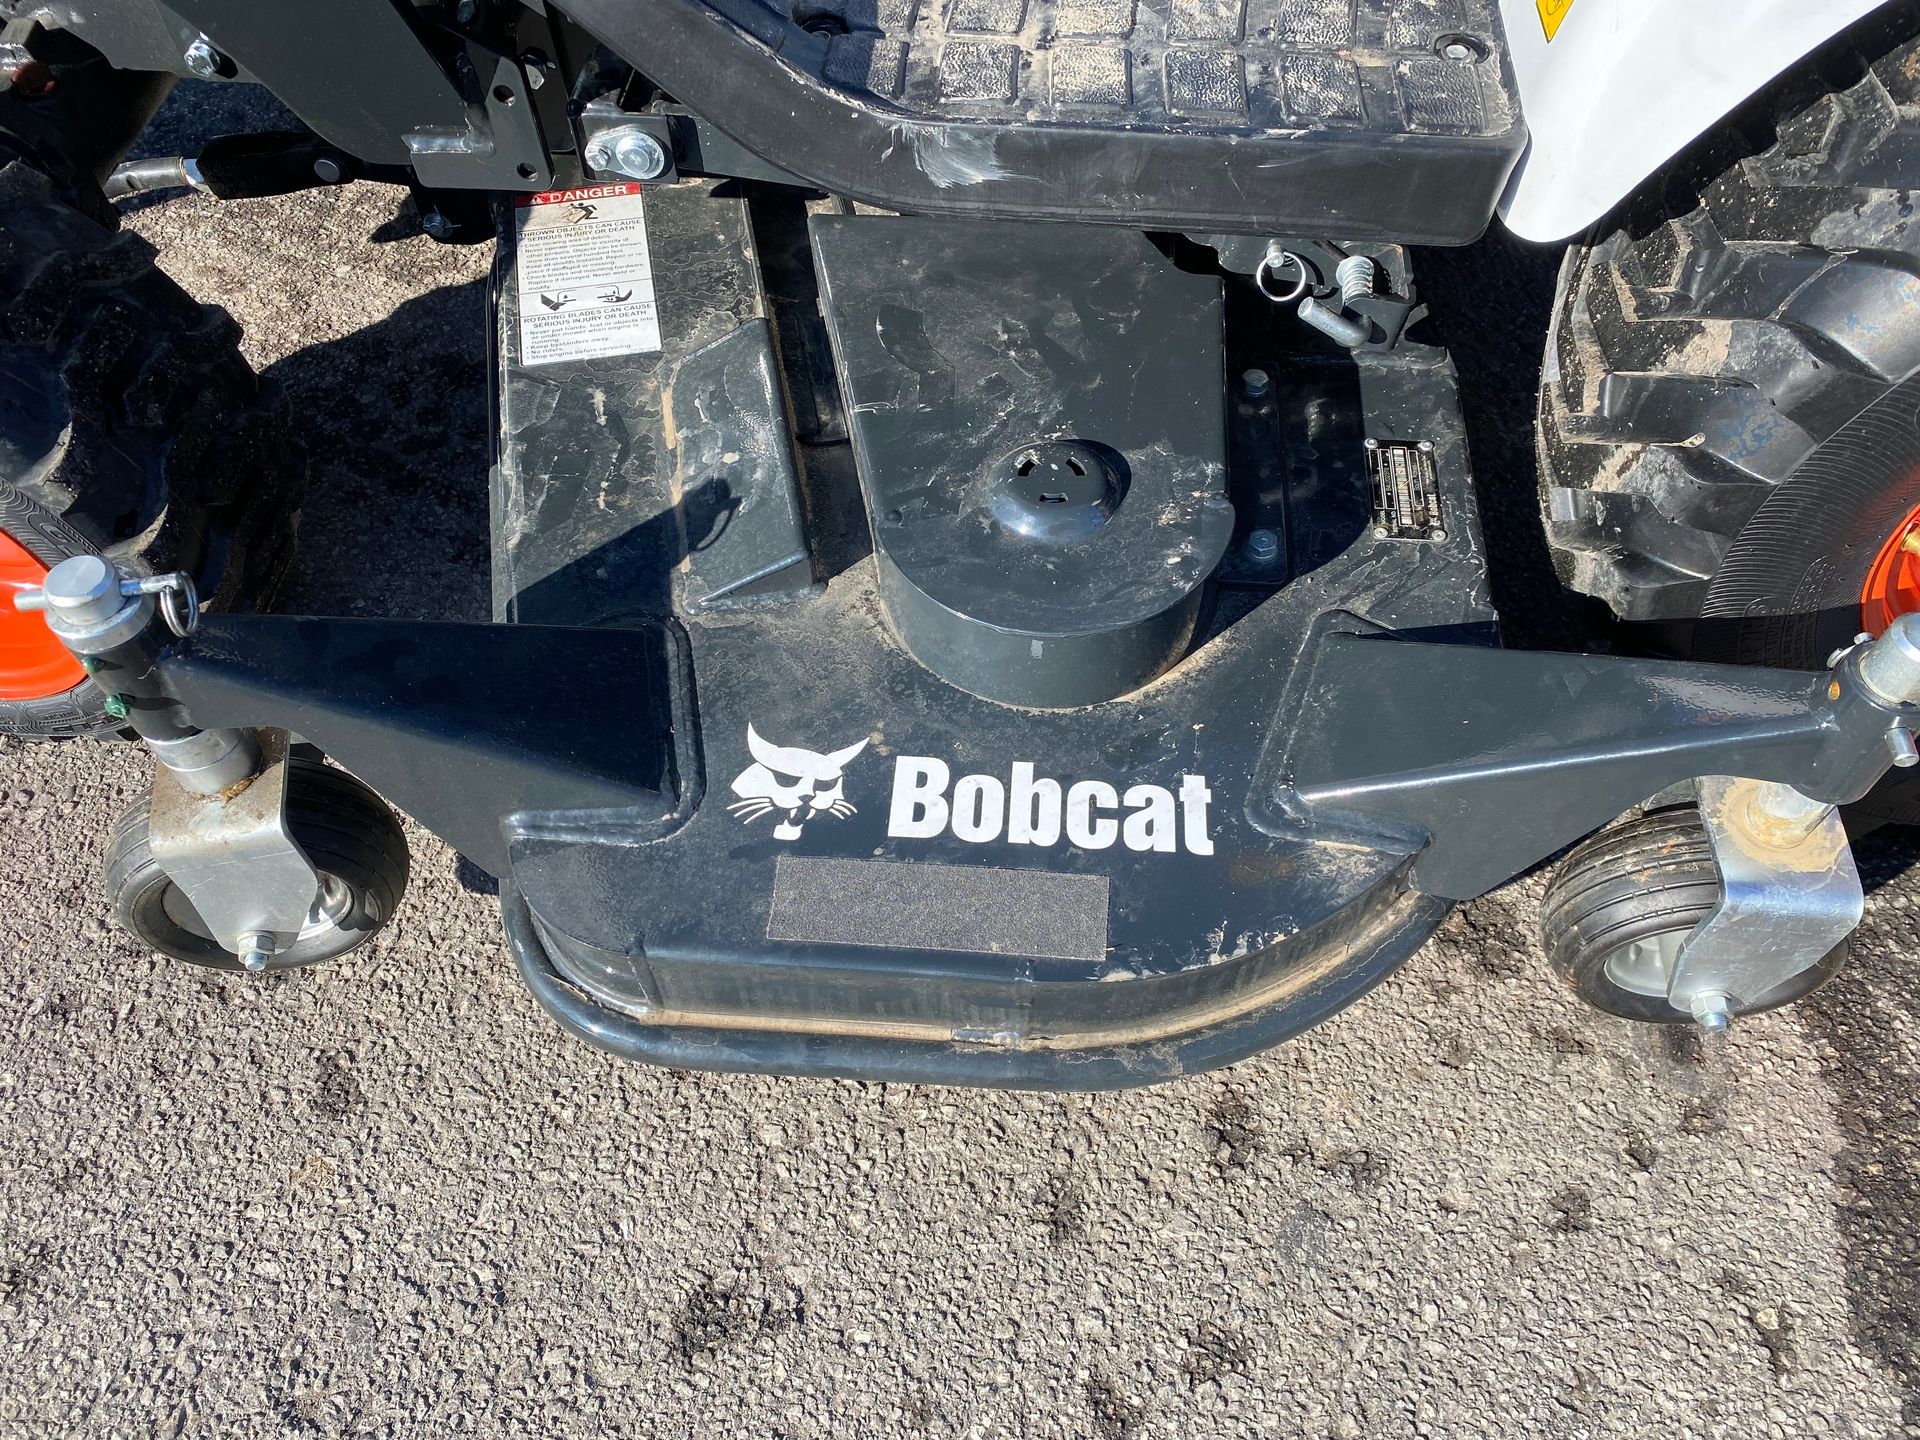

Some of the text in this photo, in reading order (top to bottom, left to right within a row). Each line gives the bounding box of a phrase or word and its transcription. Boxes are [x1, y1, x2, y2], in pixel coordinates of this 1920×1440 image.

[549, 185, 628, 202] DANGER
[520, 230, 554, 238] THROWN
[556, 225, 594, 234] OBJECTS
[528, 234, 562, 242] SERIOUS
[524, 314, 565, 323] ROTATING
[568, 310, 602, 318] BLADES
[534, 320, 570, 328] SERIOUS
[572, 315, 602, 323] INJURY
[1426, 493, 1438, 516] Bobcat
[888, 756, 1214, 856] Bobcat
